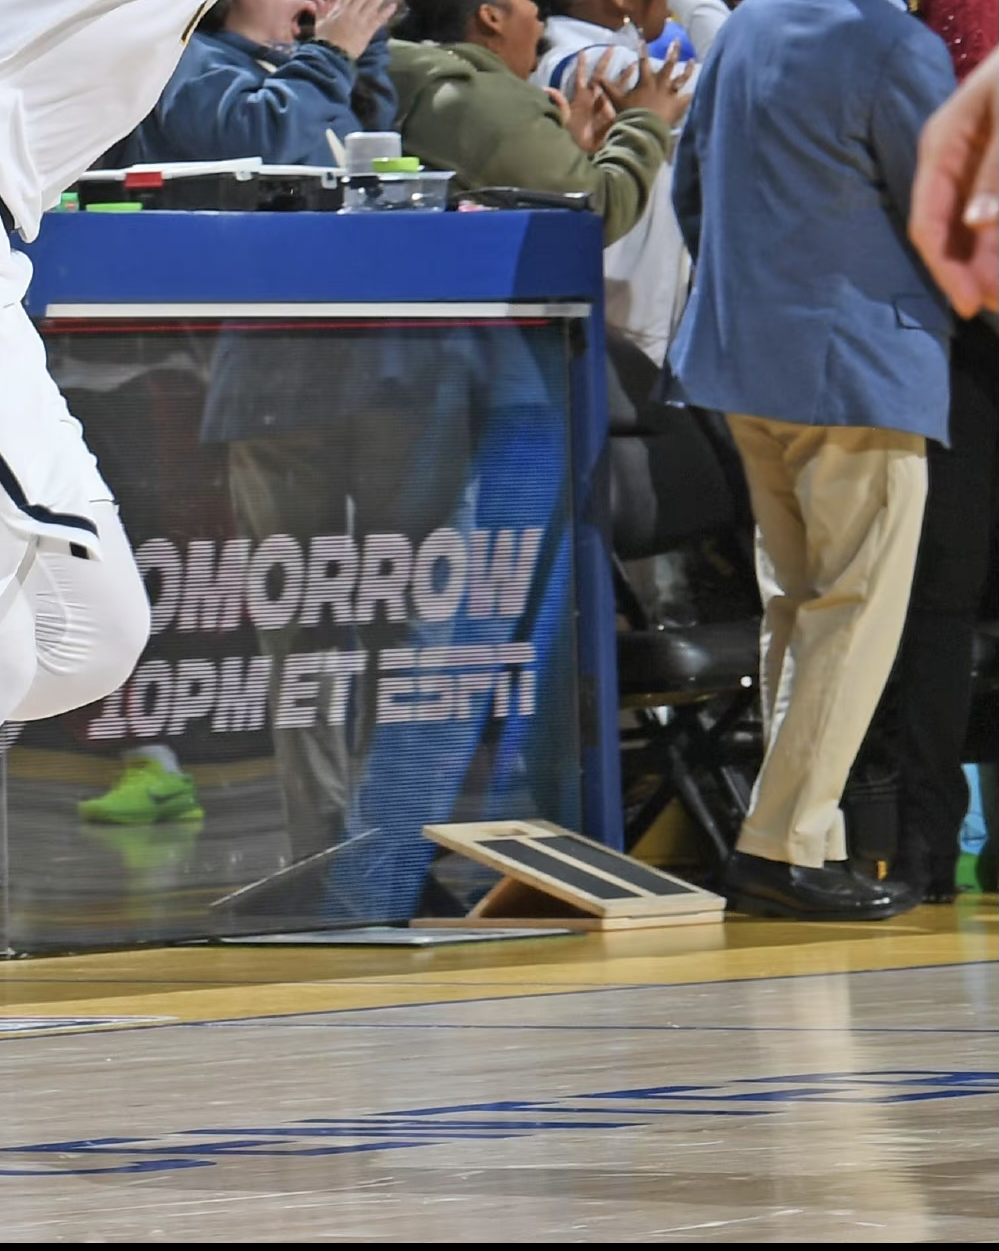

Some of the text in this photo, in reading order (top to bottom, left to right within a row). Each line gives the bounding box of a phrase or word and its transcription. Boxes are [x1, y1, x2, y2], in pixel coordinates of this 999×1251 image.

[134, 527, 544, 637] OMORROW
[275, 650, 368, 729] ET
[376, 641, 537, 725] ESPN
